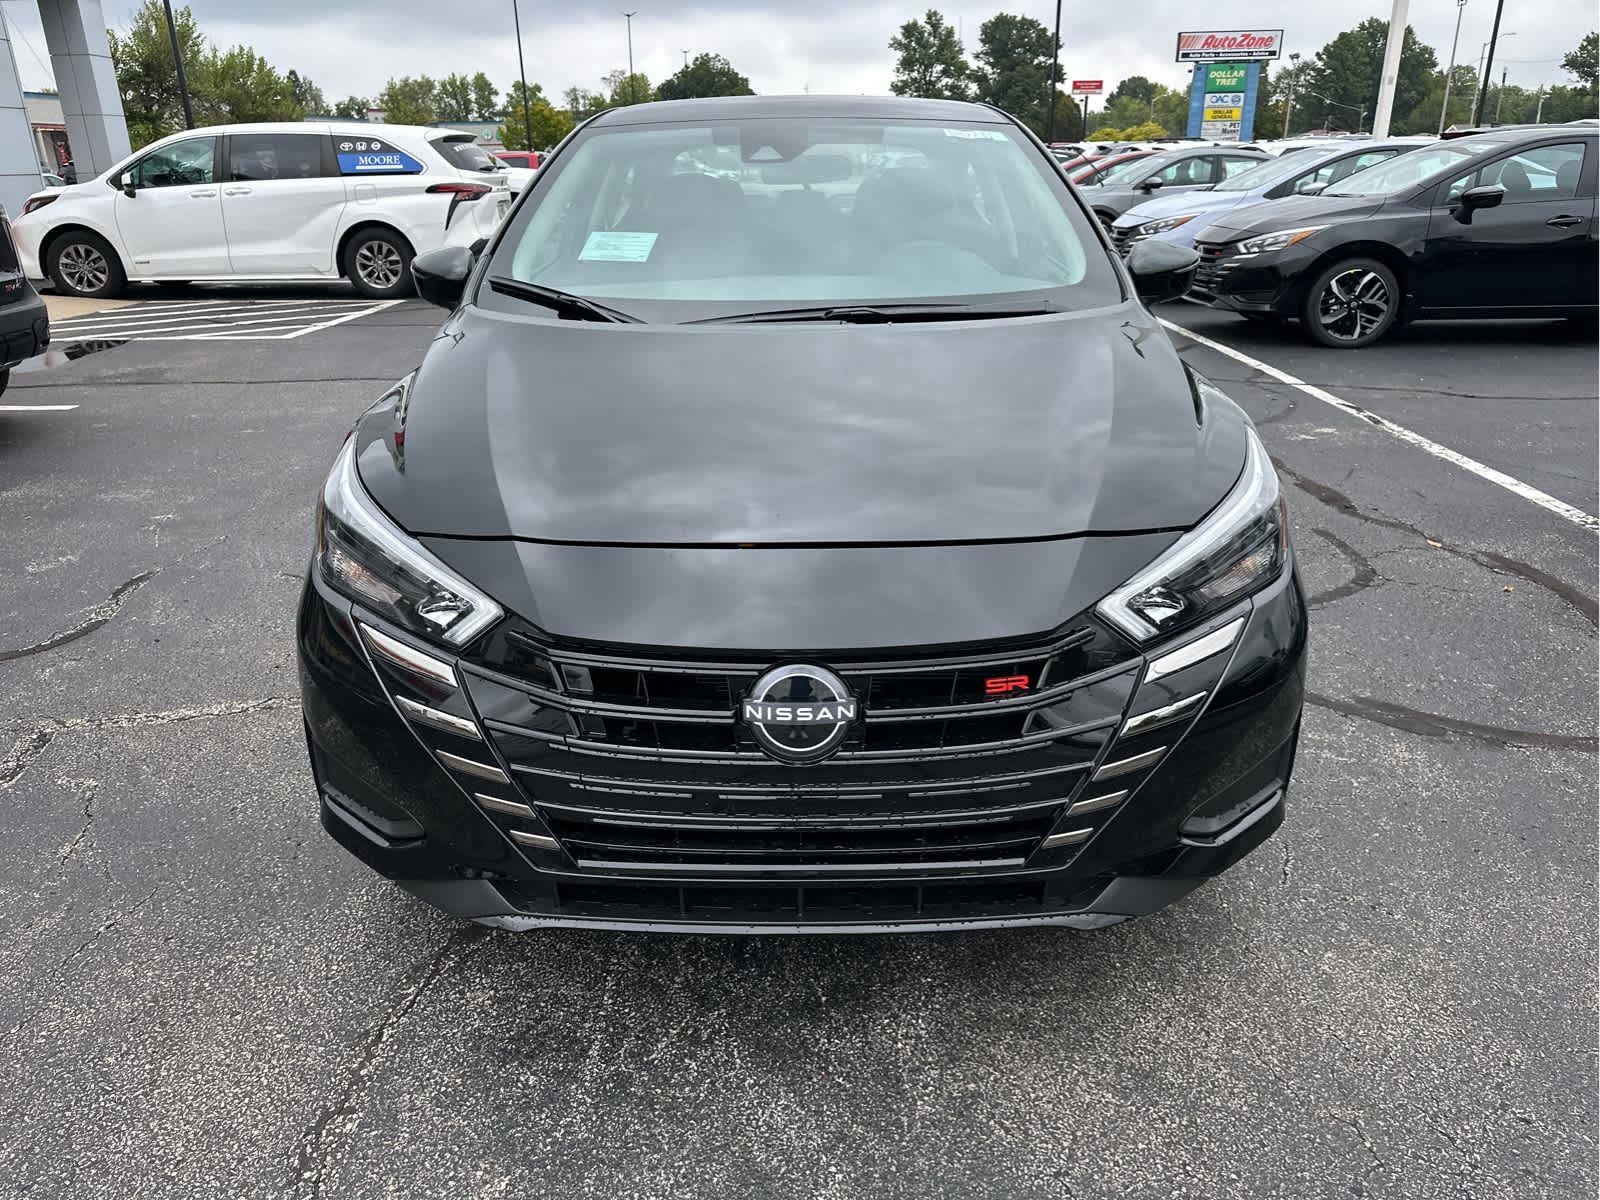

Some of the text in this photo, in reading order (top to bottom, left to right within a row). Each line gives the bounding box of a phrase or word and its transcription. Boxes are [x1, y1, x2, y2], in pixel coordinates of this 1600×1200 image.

[1202, 34, 1274, 48] AutoZone
[1209, 70, 1245, 78] DOLLAR
[1215, 78, 1237, 86] TREE
[358, 155, 400, 165] MOORE
[985, 675, 1029, 694] SR
[745, 704, 855, 721] NISSAN
